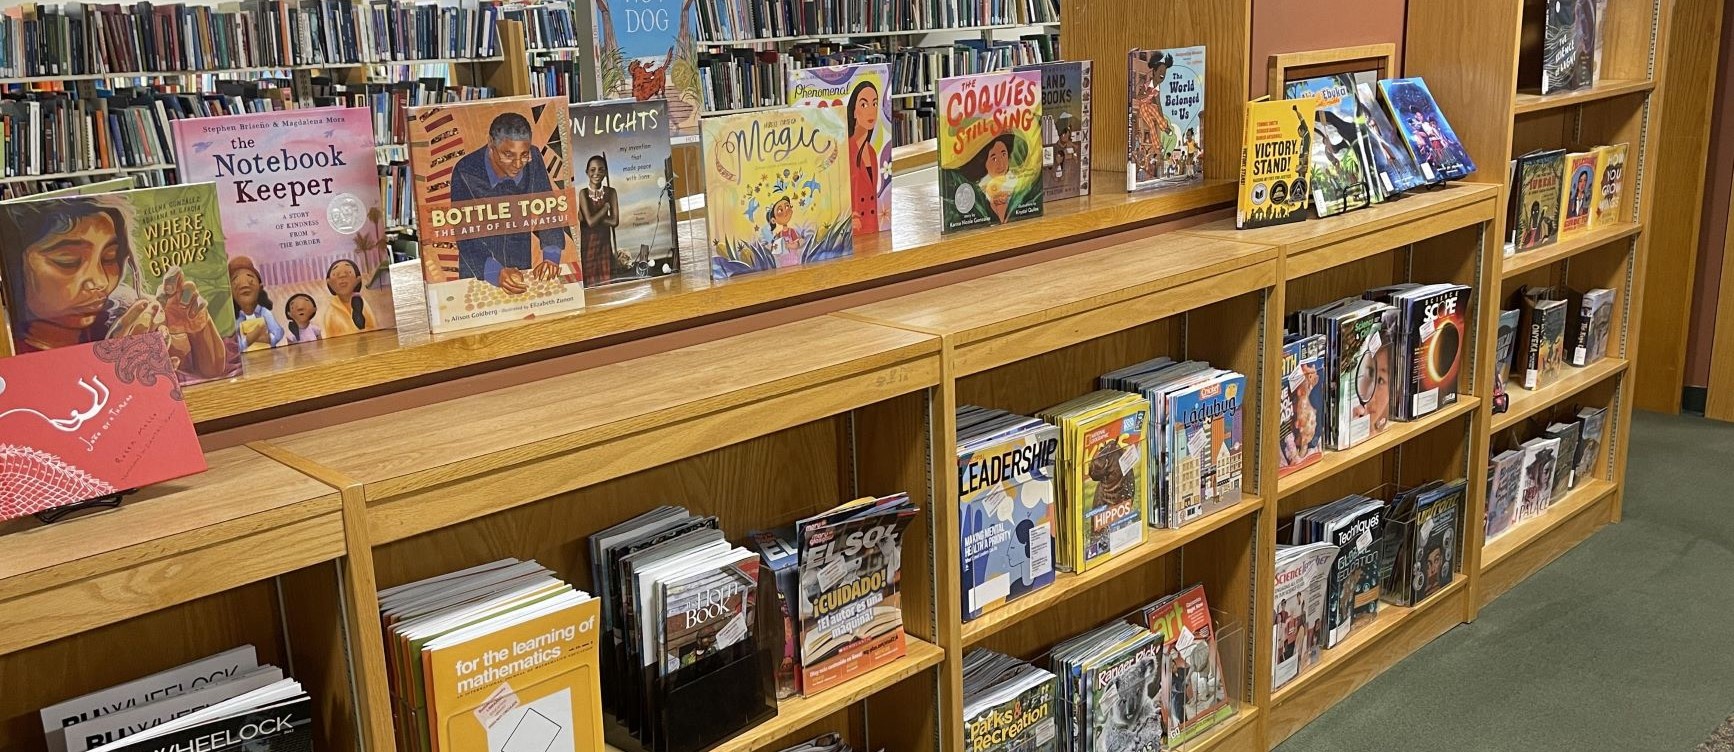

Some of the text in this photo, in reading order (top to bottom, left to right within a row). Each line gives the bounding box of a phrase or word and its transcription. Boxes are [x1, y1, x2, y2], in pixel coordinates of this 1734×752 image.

[625, 8, 669, 33] DOG
[961, 79, 977, 92] THE
[1041, 74, 1066, 89] LAND
[1169, 80, 1195, 93] World
[1172, 72, 1183, 80] The
[794, 83, 850, 99] Phenomenal
[946, 75, 1037, 127] COQUÍES
[1042, 89, 1072, 105] BOOKS
[1165, 92, 1200, 108] Belonged
[202, 125, 236, 134] Stephen
[239, 121, 270, 130] Briseño
[282, 117, 323, 128] Magdalena
[326, 116, 345, 124] Mora
[569, 109, 659, 137] N LIGHTS
[1179, 108, 1189, 120] Us
[230, 137, 255, 150] the
[953, 118, 991, 154] STILL
[1255, 139, 1298, 159] VICTORY.
[212, 144, 347, 178] Notebook
[722, 119, 831, 185] Magic
[1253, 156, 1291, 175] STAND!
[1607, 168, 1622, 181] YOU
[233, 176, 333, 207] Keeper
[1601, 182, 1621, 196] GROW
[286, 220, 319, 229] KINDNESS
[289, 211, 310, 219] STORY
[431, 195, 568, 228] BOTTLE TOPS
[144, 213, 203, 240] WHERE
[289, 230, 308, 238] FROM
[434, 214, 568, 238] THE ART OF EL ANATSUI
[144, 229, 212, 259] WONDER
[295, 238, 321, 248] BORDER
[149, 247, 207, 277] GROWS
[451, 313, 470, 322] Alison
[471, 308, 498, 319] Goldberg
[529, 298, 556, 309] Elizabeth
[1423, 296, 1458, 323] SCOPE
[1425, 290, 1460, 306] SCIENCE
[1529, 323, 1540, 353] ONYEKA
[1183, 396, 1237, 428] Ladybug
[960, 437, 1058, 497] LEADERSHIP
[1522, 486, 1538, 502] RED
[1095, 501, 1131, 528] HIPPOS
[964, 522, 1006, 546] MAKING MENTAL
[964, 540, 985, 558] HEALTH
[983, 538, 989, 550] A
[988, 529, 1012, 548] PRIORITY
[1338, 514, 1379, 546] Techniques
[760, 537, 798, 562] EL
[807, 523, 899, 570] EL SOL
[697, 581, 738, 610] Horn
[813, 569, 887, 618] ¡CUIDADO!
[830, 607, 856, 625] autor
[856, 602, 866, 612] es
[866, 592, 884, 606] una
[831, 608, 874, 639] máquina!
[1152, 601, 1185, 645] art
[455, 657, 480, 677] for
[482, 646, 509, 667] the
[512, 624, 576, 656] learning
[578, 614, 596, 633] of
[457, 646, 562, 694] mathematics
[970, 700, 1022, 741] Parks &
[973, 702, 1048, 752] Recreation
